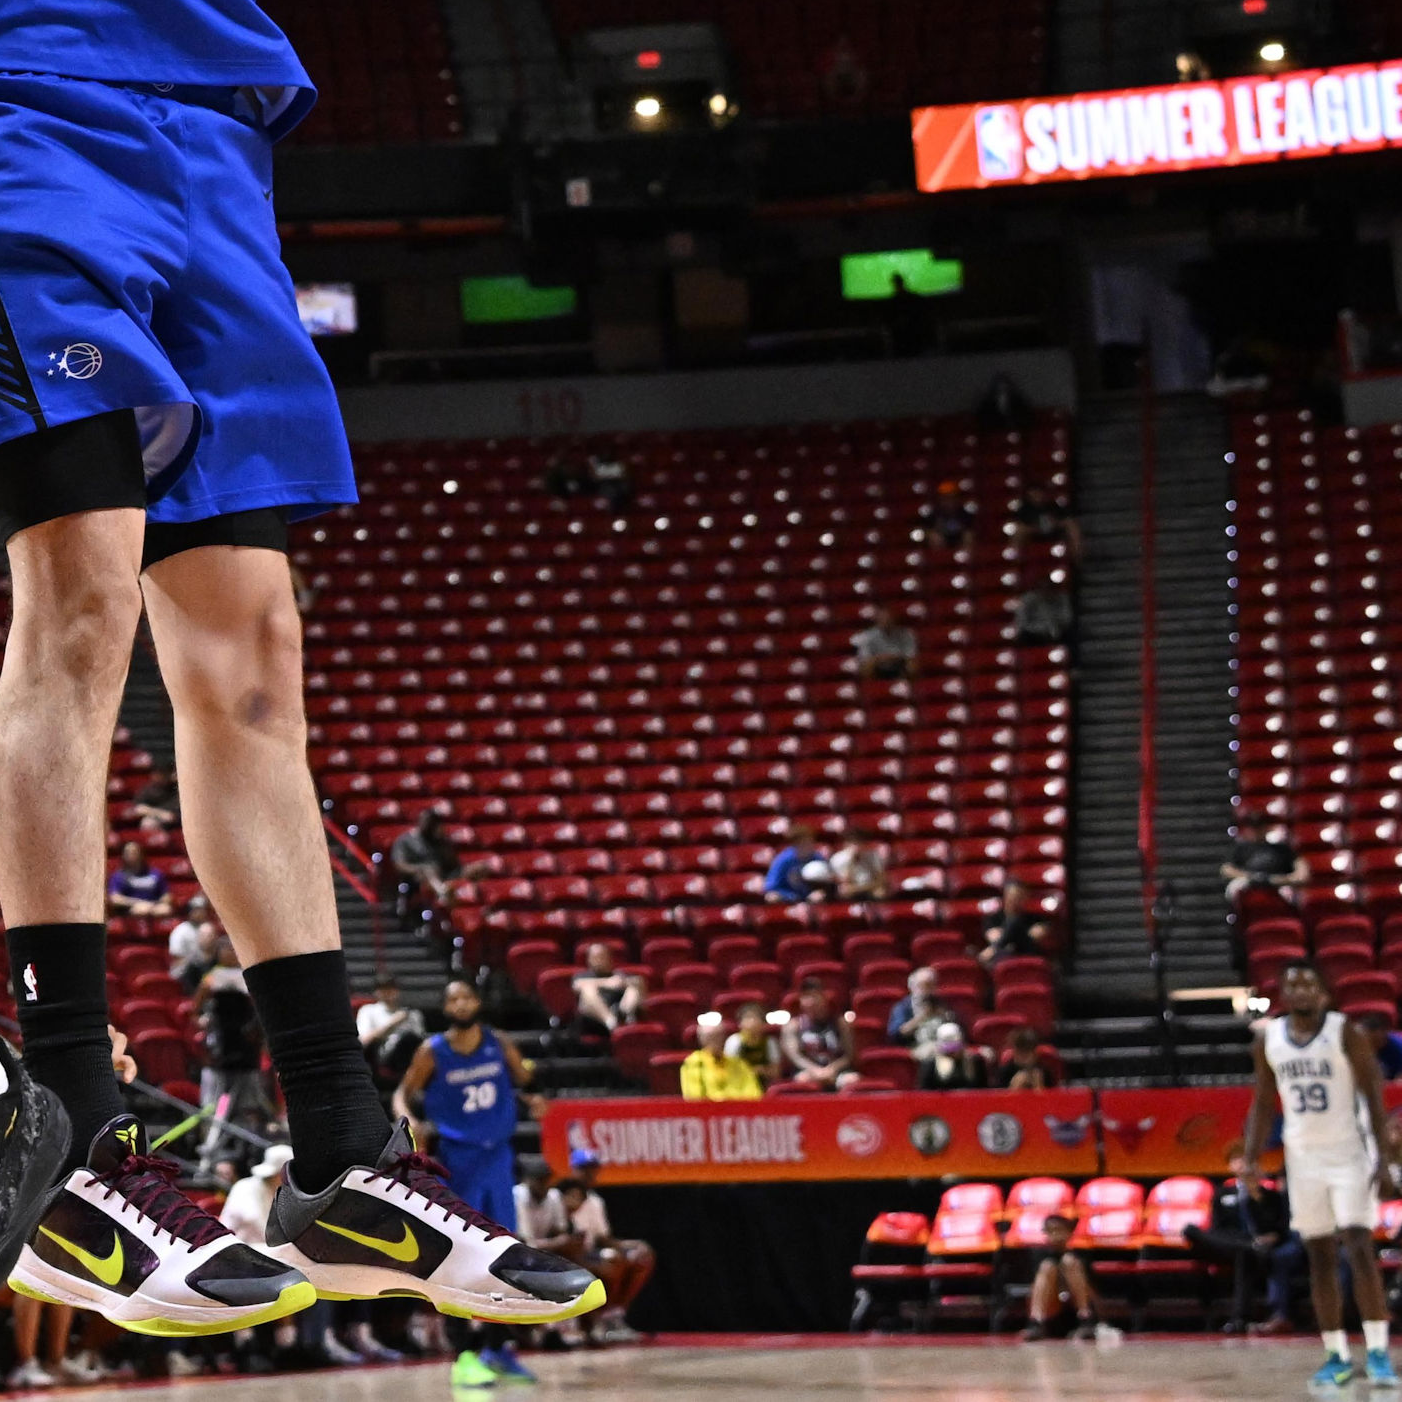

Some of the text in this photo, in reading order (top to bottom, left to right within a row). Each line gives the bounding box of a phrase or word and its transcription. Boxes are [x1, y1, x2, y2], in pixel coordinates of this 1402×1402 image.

[1023, 87, 1228, 174] SUMMER
[462, 1084, 497, 1113] 20
[1290, 1083, 1328, 1113] 39
[592, 1115, 806, 1165] SUMMER LEAGUE
